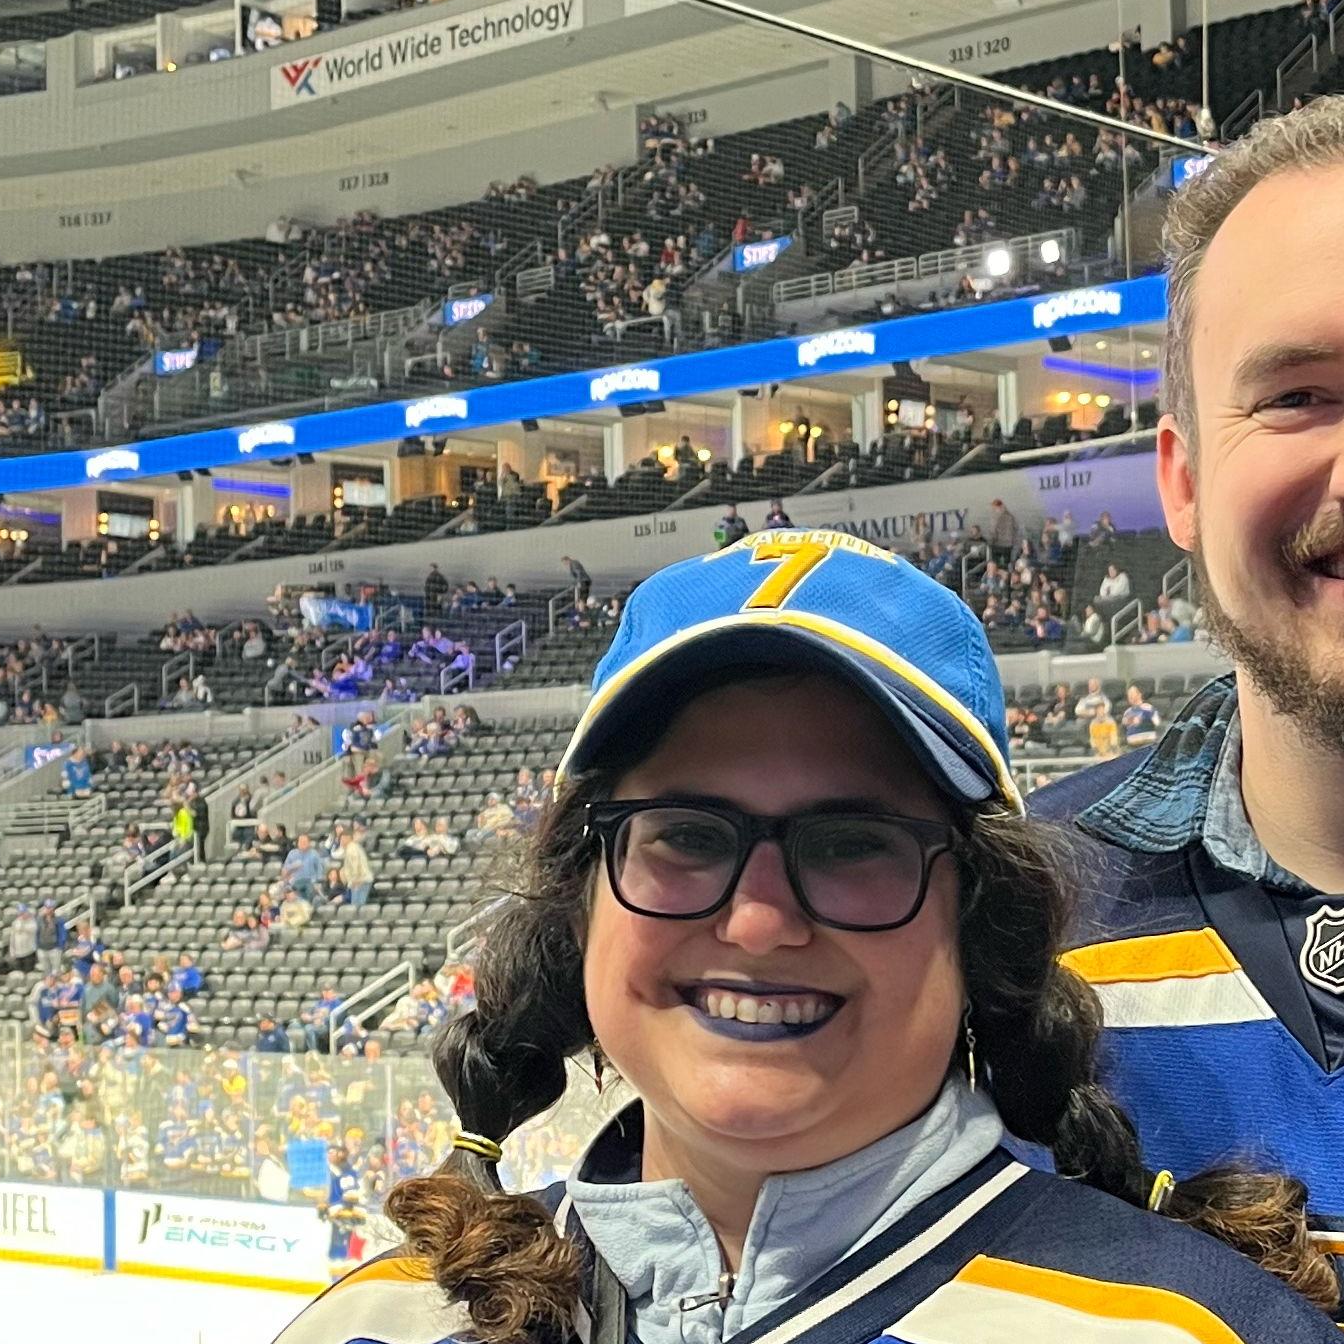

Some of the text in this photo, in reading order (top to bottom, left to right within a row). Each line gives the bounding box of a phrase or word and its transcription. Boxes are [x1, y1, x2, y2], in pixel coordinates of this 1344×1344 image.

[325, 0, 574, 83] World Wide Technology
[984, 36, 1010, 56] 320
[739, 542, 833, 613] 7
[164, 1226, 301, 1254] ENERGY
